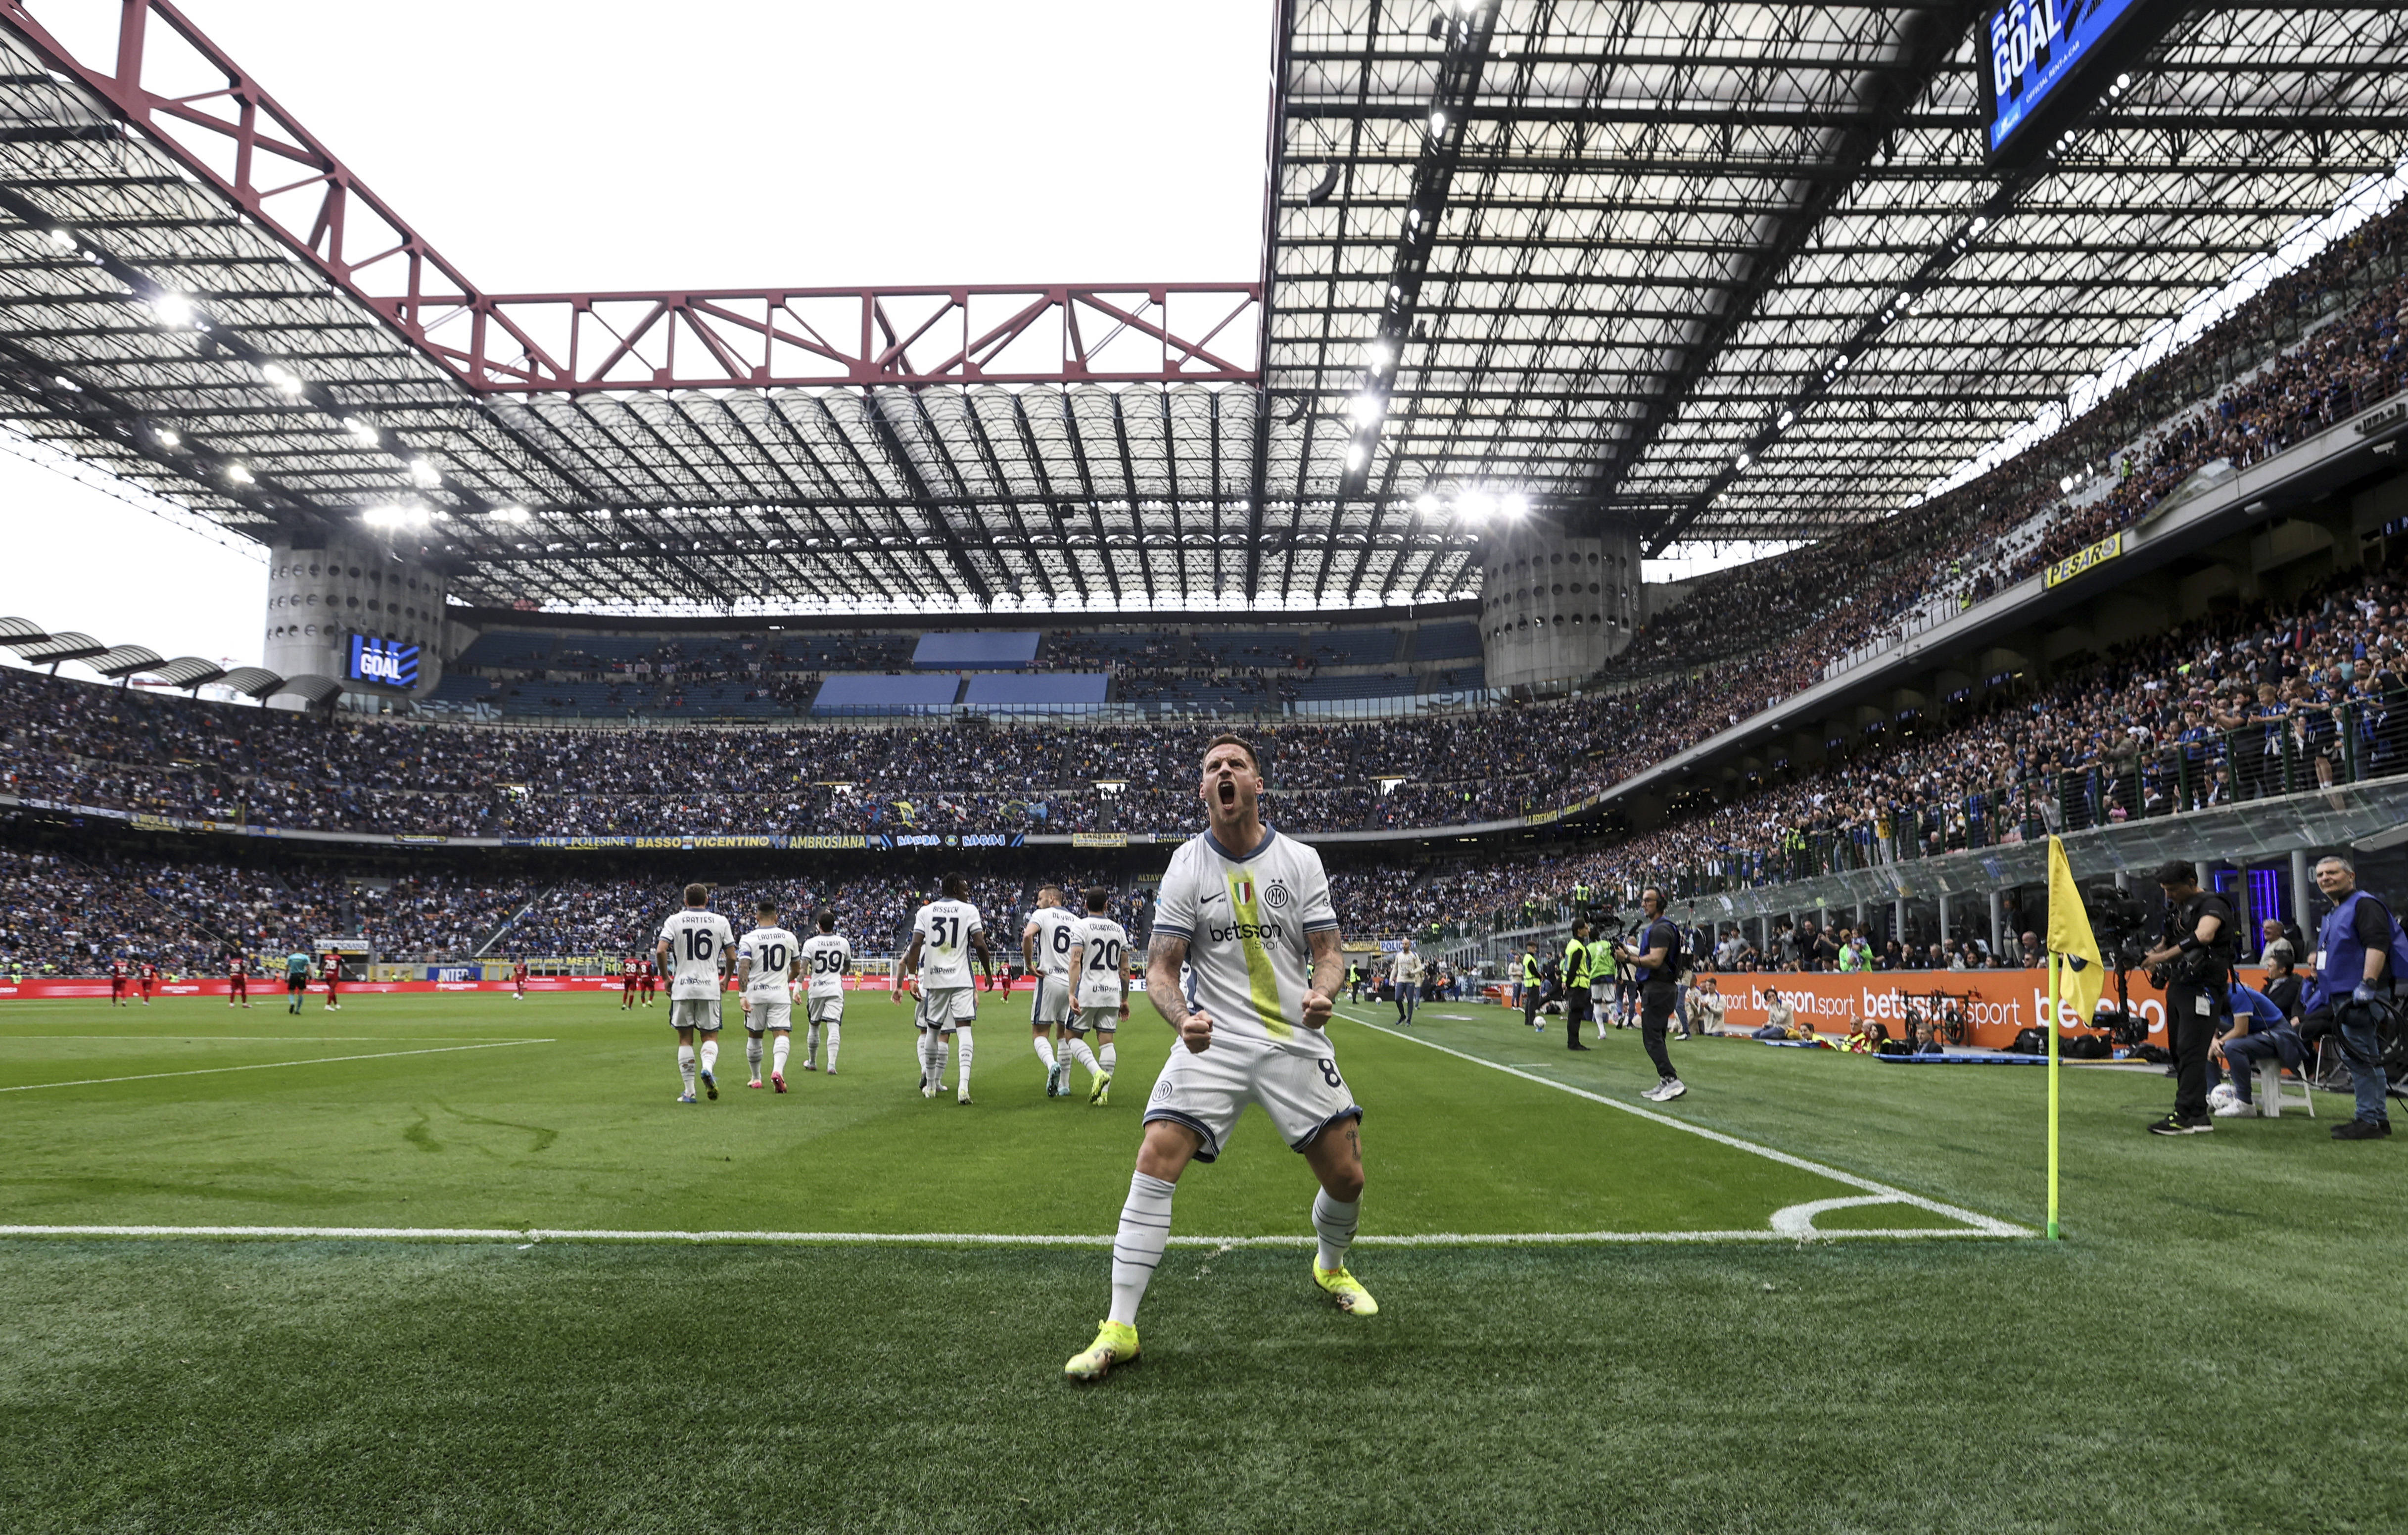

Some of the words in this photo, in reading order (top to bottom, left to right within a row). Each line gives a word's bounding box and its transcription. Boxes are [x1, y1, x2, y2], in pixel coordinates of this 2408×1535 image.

[1993, 0, 2061, 96] GOAL
[2026, 76, 2048, 104] OFFICIAL
[360, 653, 402, 680] GOAL
[571, 836, 627, 847] POLESINE
[635, 837, 682, 848] BASSO
[693, 836, 769, 847] VICENTINO
[789, 835, 867, 849] AMBROSIANA
[682, 928, 713, 960] 16
[931, 916, 959, 948] 31
[1053, 925, 1071, 954] 6
[1210, 921, 1281, 942] betsson
[325, 959, 337, 969] 26
[759, 944, 786, 972] 10
[815, 950, 842, 973] 59
[1089, 938, 1120, 971] 20
[143, 968, 151, 976] 9
[625, 963, 637, 973] 28
[641, 964, 647, 973] 8
[1319, 1058, 1341, 1088] 8
